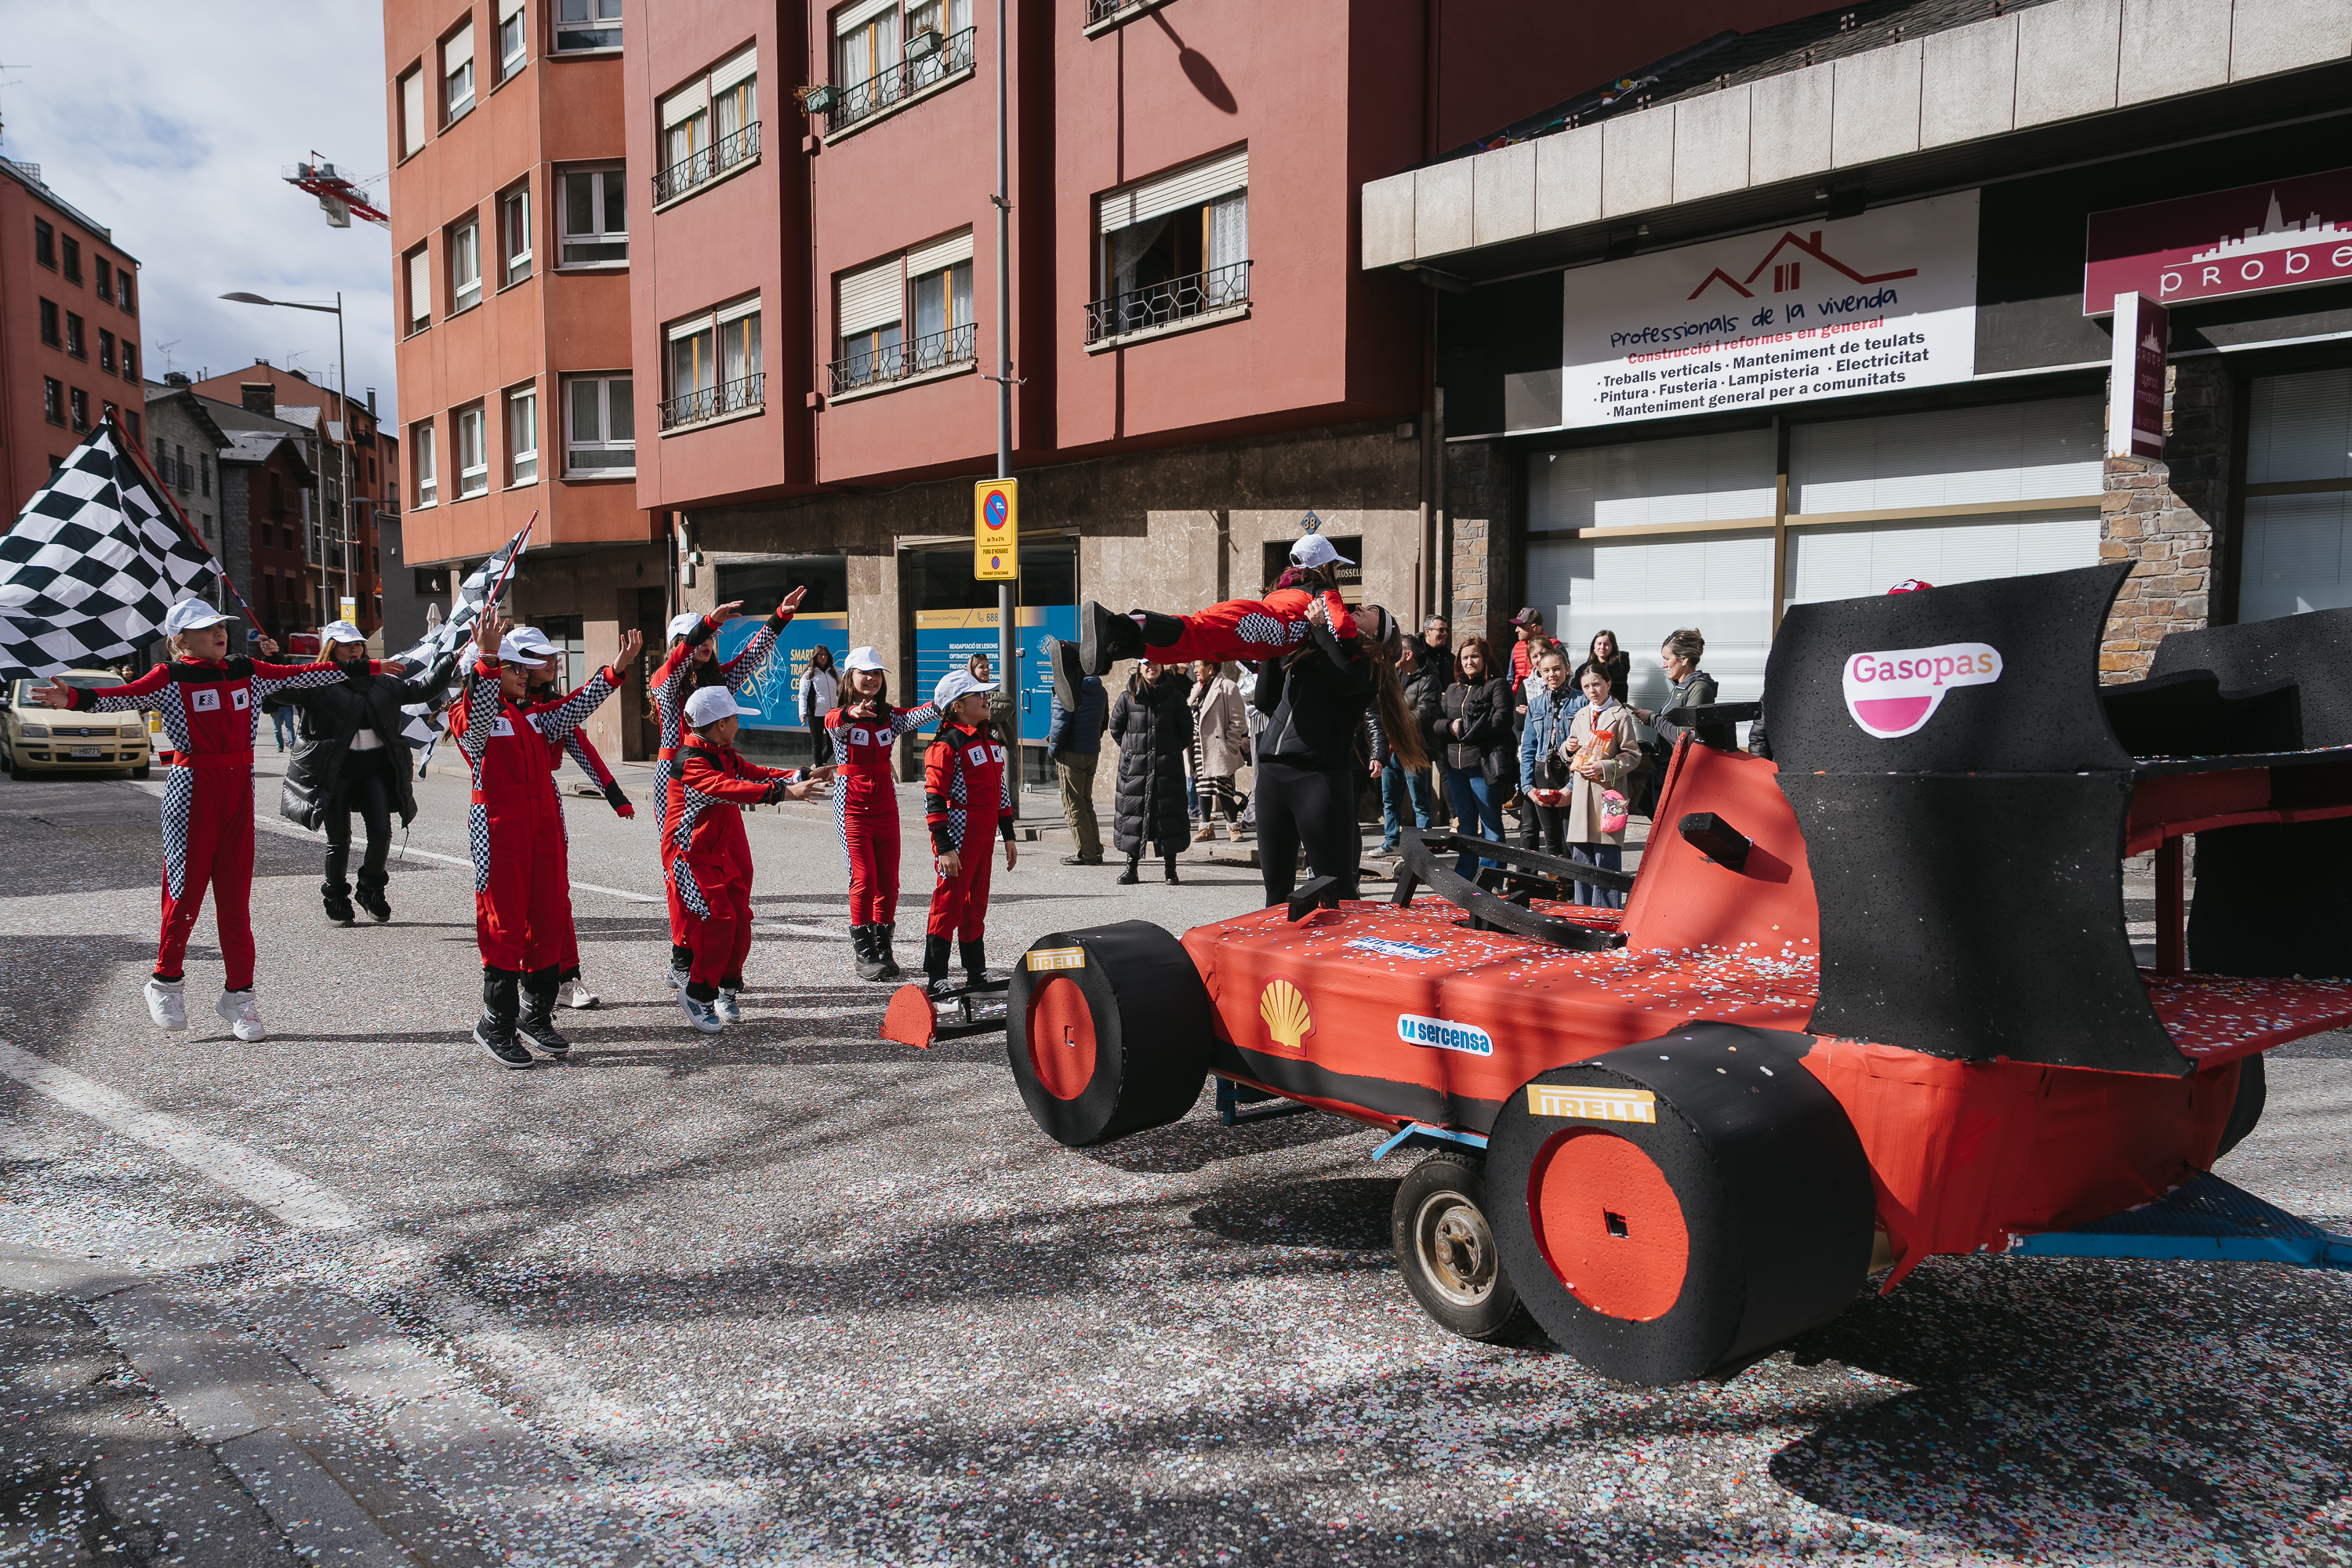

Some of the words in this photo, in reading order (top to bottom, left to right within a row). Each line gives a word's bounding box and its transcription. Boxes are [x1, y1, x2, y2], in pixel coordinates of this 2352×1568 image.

[1751, 307, 1775, 327] de
[1786, 303, 1805, 323] la
[1817, 287, 1898, 316] vivenda
[1604, 370, 1657, 387] Treballs
[1661, 361, 1722, 379] verticals
[1733, 343, 1835, 370] Manteniment
[1840, 341, 1860, 354] de
[1865, 332, 1926, 350] teulats
[1628, 339, 1711, 365] Construcció
[1715, 339, 1720, 351] i
[1724, 330, 1792, 350] reformes
[1798, 327, 1817, 339] en
[1820, 314, 1884, 339] general
[1600, 387, 1649, 404] Pintura
[1659, 377, 1718, 396] Fusteria
[1729, 364, 1820, 387] Lampisteria
[1836, 348, 1929, 372] Electricitat
[1613, 395, 1705, 418] Manteniment
[1708, 387, 1765, 408] general
[1769, 385, 1795, 401] per
[1799, 384, 1808, 394] a
[1813, 371, 1907, 393] comunitats
[1303, 517, 1316, 529] 38
[986, 613, 999, 622] 688
[1853, 653, 1993, 685] Gasopas
[1417, 1022, 1490, 1053] sercensa
